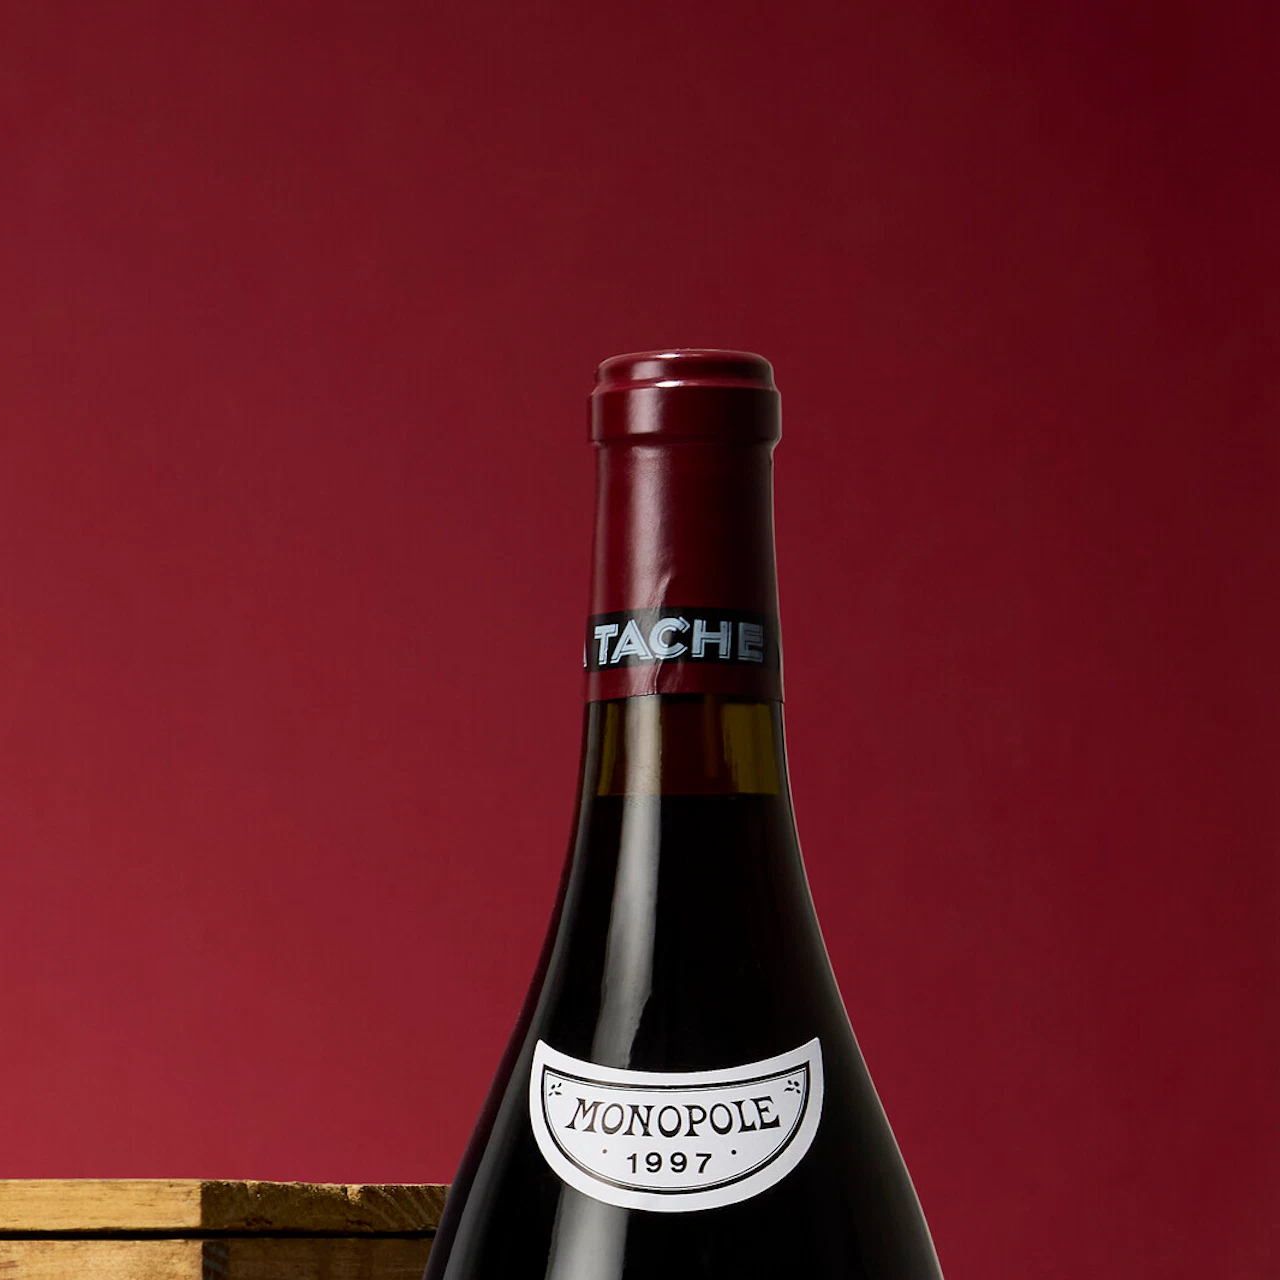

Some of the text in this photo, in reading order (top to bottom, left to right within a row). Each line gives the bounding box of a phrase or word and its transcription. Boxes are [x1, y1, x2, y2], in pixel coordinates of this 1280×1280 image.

[595, 617, 764, 665] TACHE
[565, 1096, 781, 1138] MONOPOLE
[626, 1152, 712, 1173] 1997
